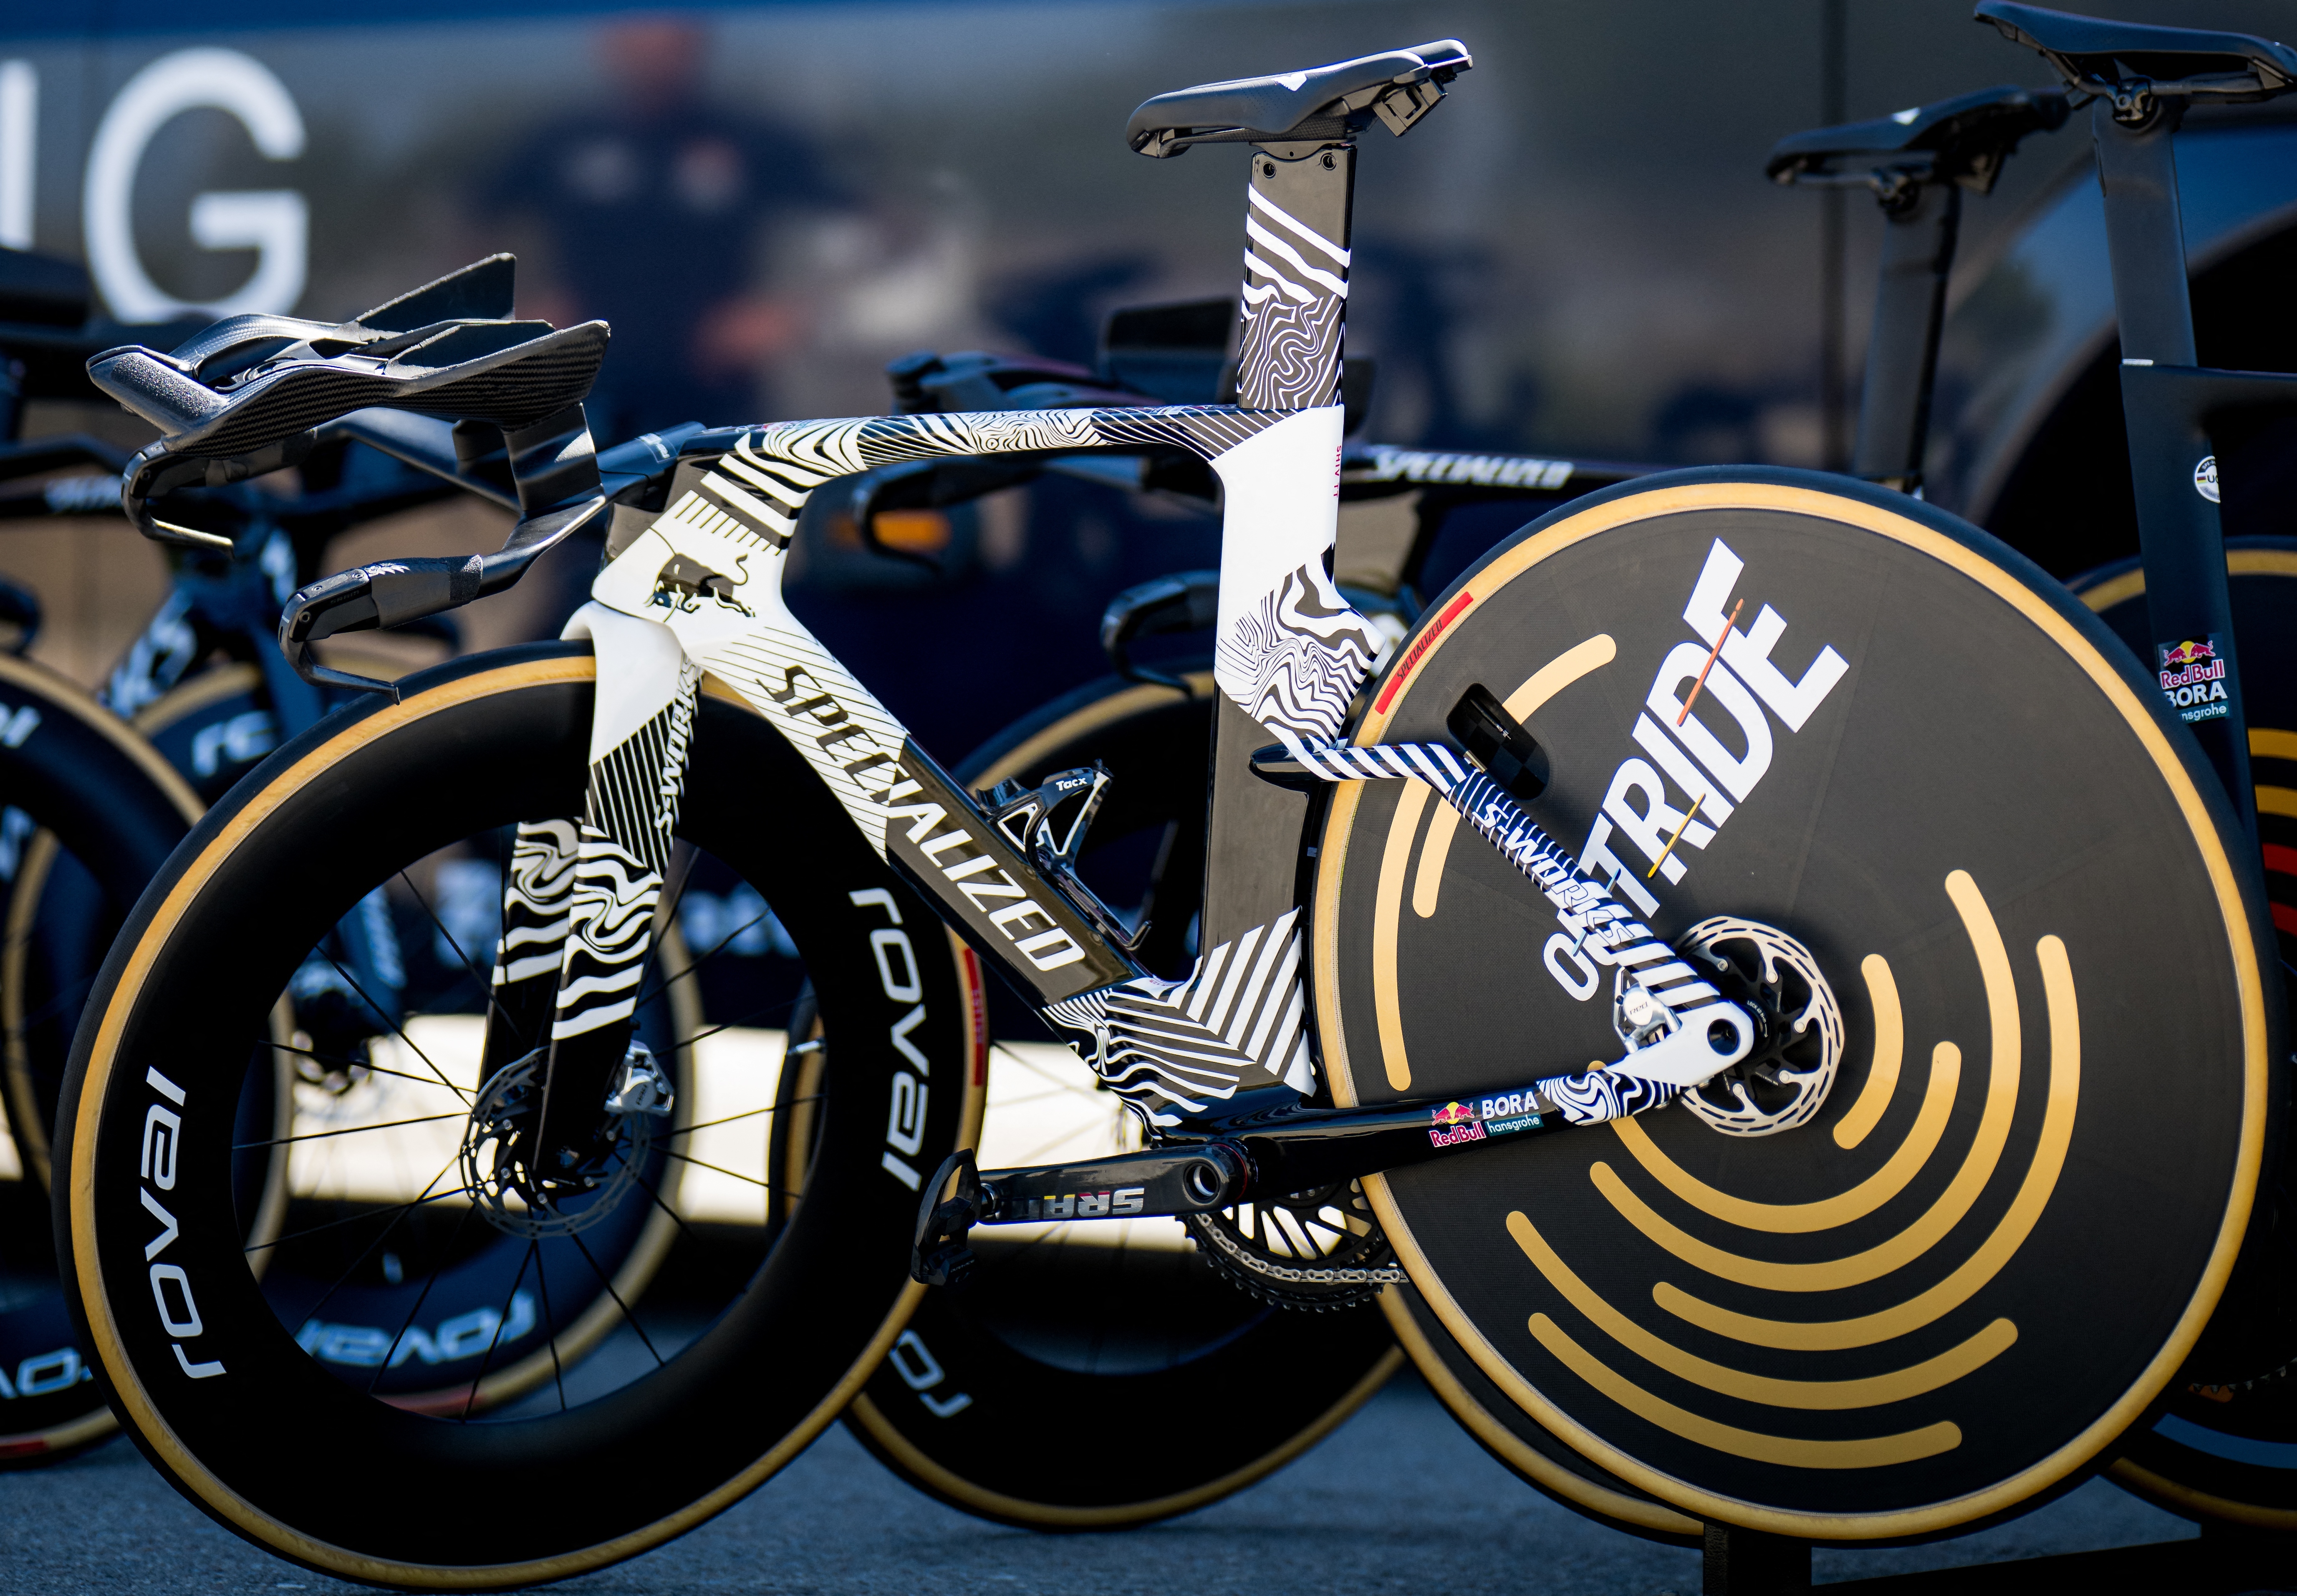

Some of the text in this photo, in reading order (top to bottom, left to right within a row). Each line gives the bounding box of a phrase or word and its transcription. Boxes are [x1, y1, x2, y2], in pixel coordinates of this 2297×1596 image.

[1333, 482, 1339, 498] TT
[329, 590, 360, 605] SRAM
[1396, 619, 1443, 683] SPECIALIZED
[2160, 659, 2225, 689] Red Bull
[2181, 703, 2227, 721] nsgrohe
[1055, 778, 1088, 791] Tacx
[756, 665, 1085, 971] SPECIALIZED
[1472, 803, 1636, 946] S-WORKS
[848, 888, 929, 1191] roval
[1482, 1091, 1539, 1119] BORA
[1429, 1121, 1487, 1147] Red Bull
[1487, 1114, 1540, 1133] hansgrohe
[141, 1065, 227, 1379] roval
